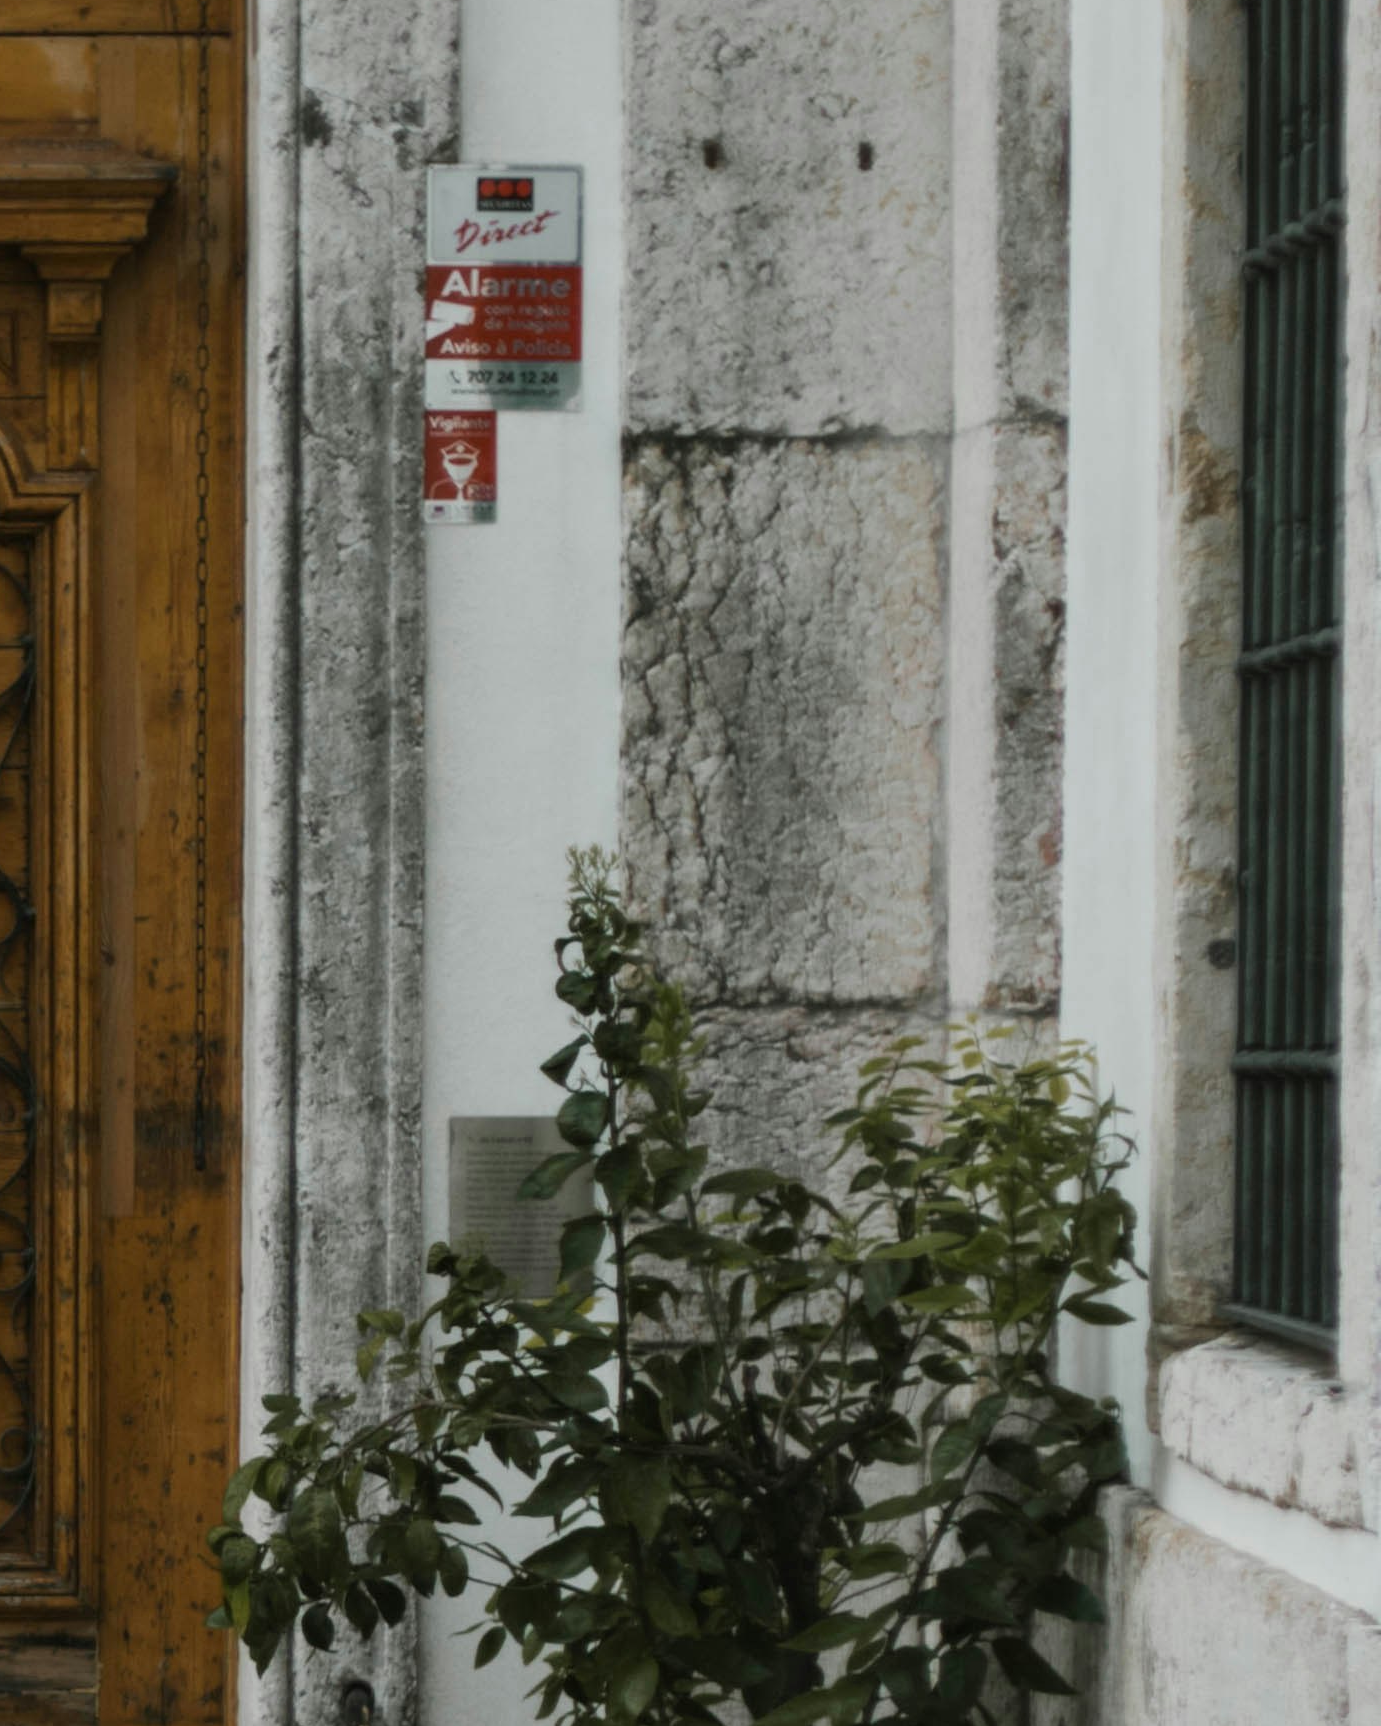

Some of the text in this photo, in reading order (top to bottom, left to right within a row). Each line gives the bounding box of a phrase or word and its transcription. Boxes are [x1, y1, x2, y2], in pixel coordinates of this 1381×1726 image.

[454, 210, 560, 253] Direct
[440, 268, 571, 298] Alarme
[484, 304, 515, 315] com
[484, 317, 504, 331] de
[440, 339, 490, 354] Aviso
[468, 370, 558, 384] 707 24 12 24
